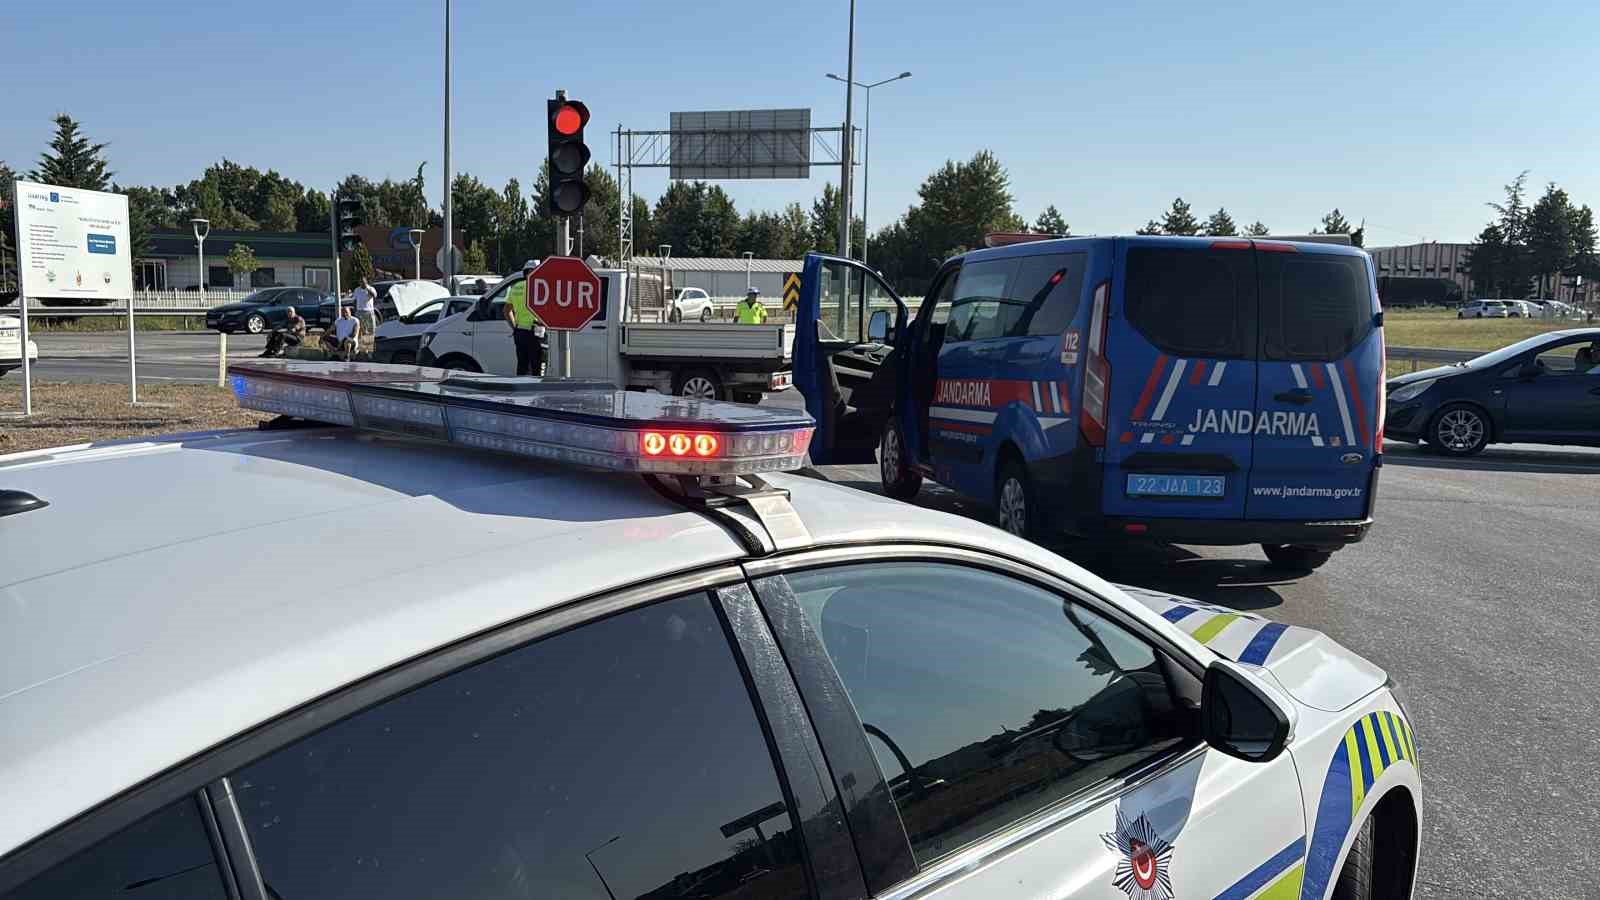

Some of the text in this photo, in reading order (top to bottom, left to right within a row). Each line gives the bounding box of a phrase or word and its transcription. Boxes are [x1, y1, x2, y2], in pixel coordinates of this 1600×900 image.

[533, 278, 593, 309] DUR
[1064, 332, 1079, 350] 112
[937, 381, 991, 407] JANDARMA
[1187, 409, 1320, 436] JANDARMA
[1137, 478, 1221, 494] 22 JAA 123
[1252, 485, 1362, 499] www.jandarma.gov.tr
